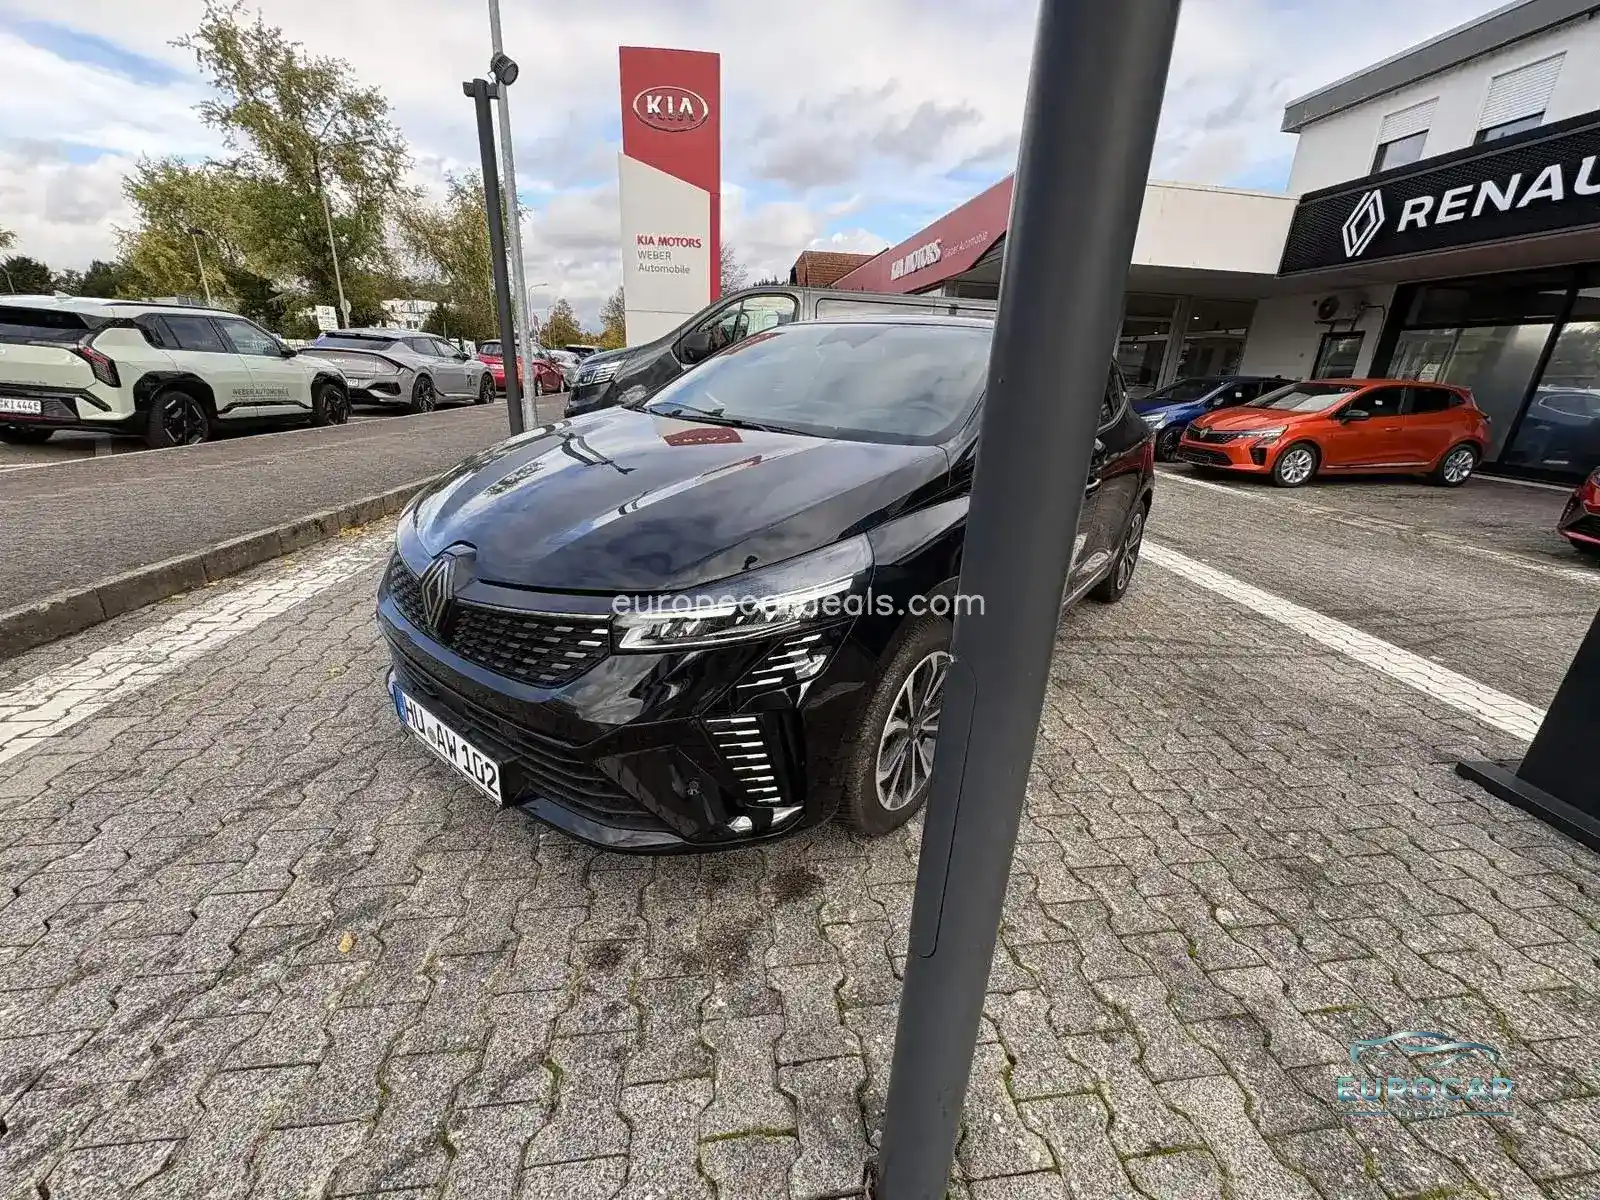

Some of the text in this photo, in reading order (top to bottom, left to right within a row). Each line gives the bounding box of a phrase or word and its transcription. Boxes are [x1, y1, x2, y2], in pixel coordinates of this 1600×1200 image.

[646, 95, 694, 116] KIA
[637, 235, 702, 248] KIA MOTORS
[638, 250, 672, 260] WEBER
[639, 263, 690, 274] Automobile
[405, 701, 500, 796] HU AW 102
